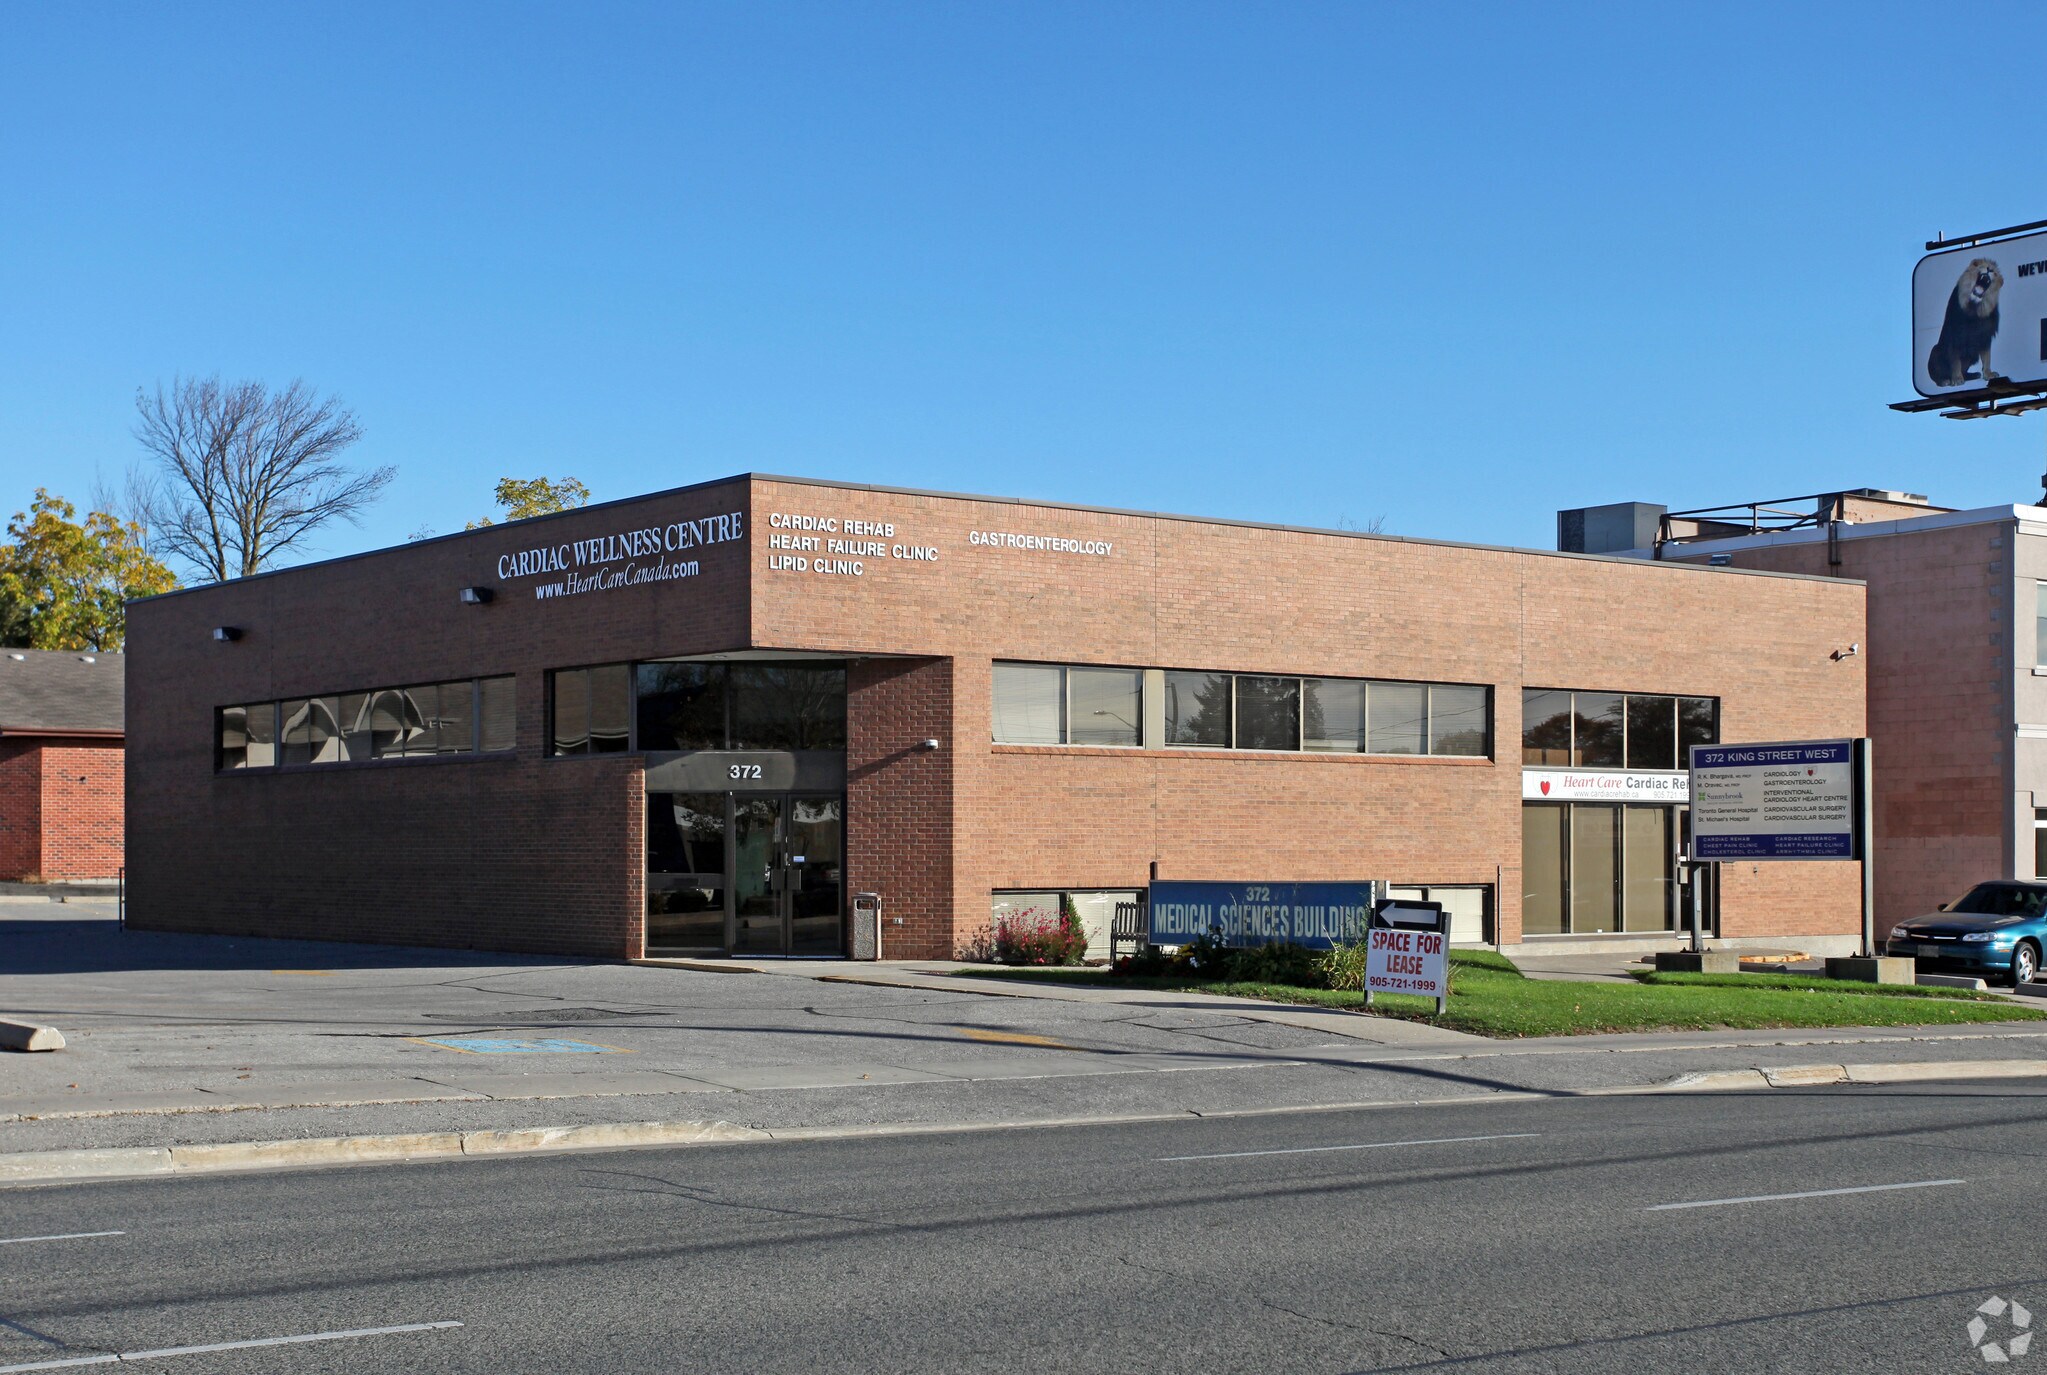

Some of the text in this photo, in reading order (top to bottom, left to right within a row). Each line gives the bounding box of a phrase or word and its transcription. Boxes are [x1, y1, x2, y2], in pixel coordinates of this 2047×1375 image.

[769, 512, 895, 538] CARDIAC REHAB
[498, 512, 743, 580] CARDIAC WELLNESS CENTRE
[769, 534, 938, 562] HEART FAILURE CLINIC
[969, 530, 1113, 556] GASTROENTEROLOGY
[769, 555, 863, 576] LIPID CLINIC
[536, 556, 699, 600] www.HeartCareCanada.com
[1705, 749, 1838, 763] 372 KING STREET WEST
[730, 765, 762, 779] 372
[1563, 775, 1595, 788] Heart
[1597, 775, 1622, 789] Care
[1626, 776, 1669, 790] Cardiac
[1574, 789, 1639, 798] www.cardiacrehab.ca
[1707, 792, 1743, 801] Sunnybrook
[1246, 886, 1270, 902] 372
[1154, 903, 1212, 937] MEDICAL
[1220, 904, 1290, 937] SCIENCES
[1372, 931, 1442, 955] SPACE FOR
[1386, 954, 1423, 975] LEASE
[1369, 976, 1436, 991] 905-721-1999
